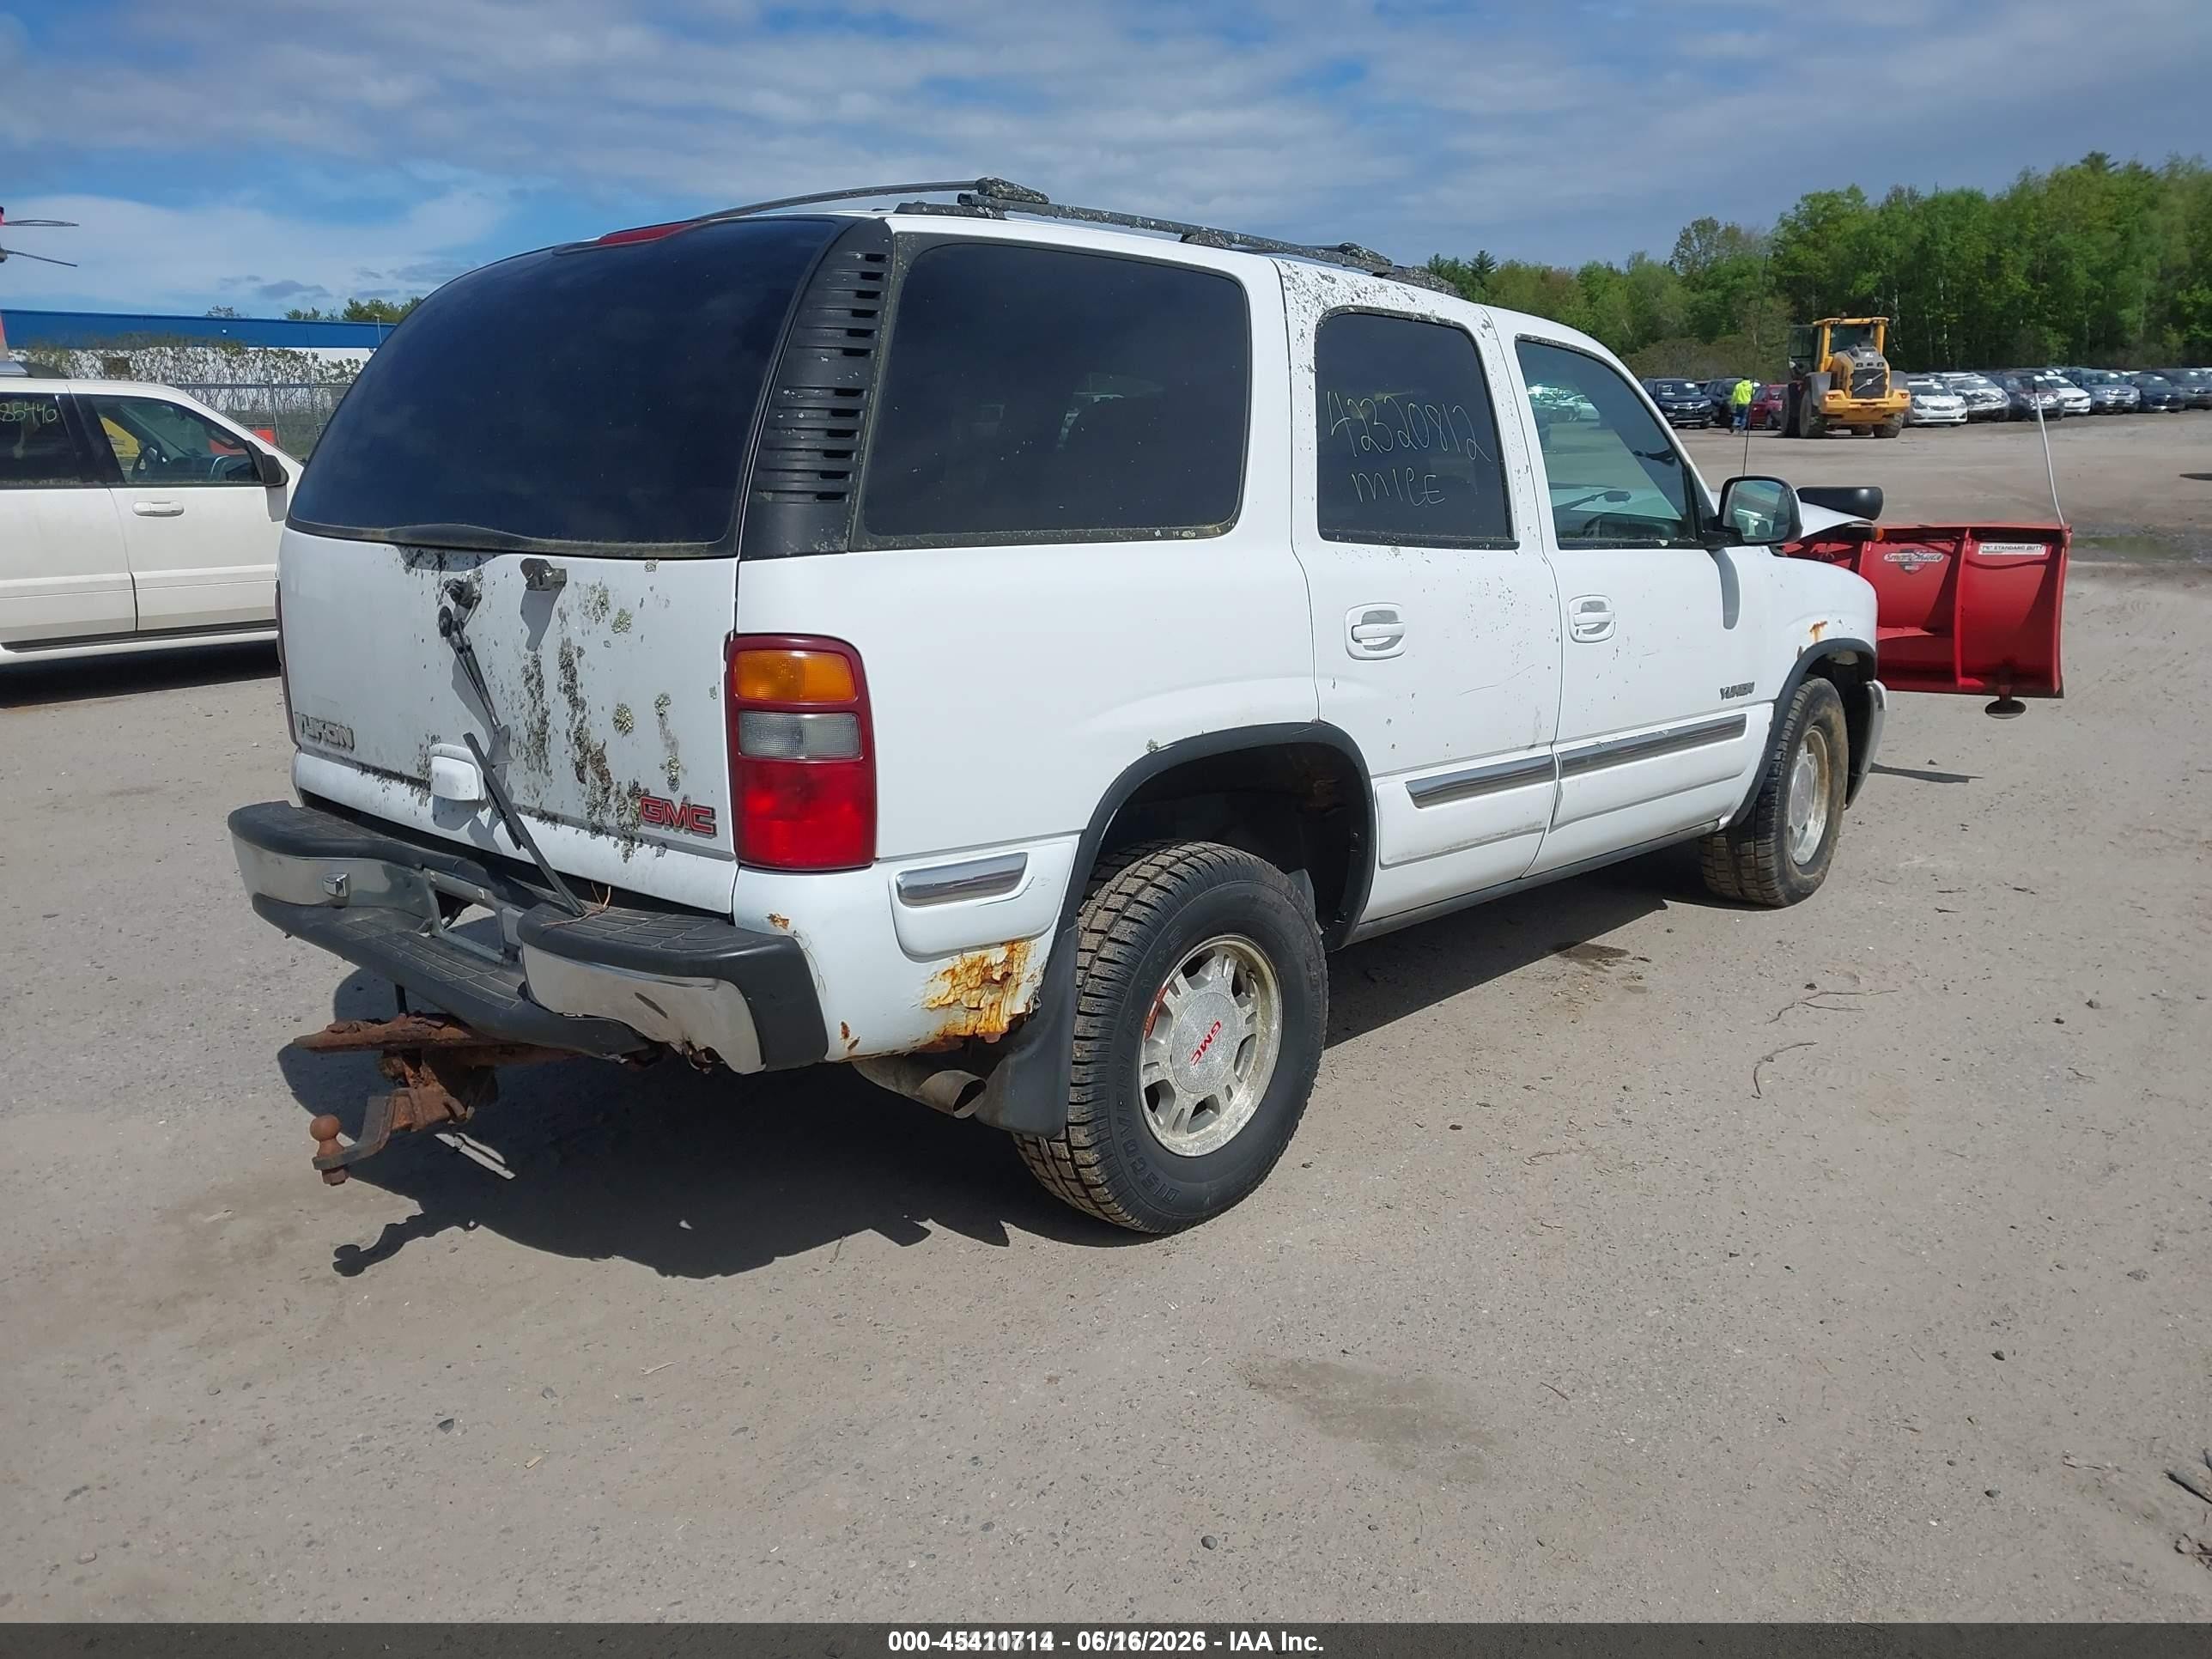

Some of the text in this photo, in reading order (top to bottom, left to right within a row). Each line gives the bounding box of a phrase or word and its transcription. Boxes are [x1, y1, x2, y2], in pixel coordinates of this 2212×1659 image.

[0, 401, 58, 423] 85440
[1327, 391, 1492, 462] 42320812
[295, 712, 356, 750] YUKON
[639, 794, 717, 836] GMC
[1189, 1019, 1223, 1066] GMC
